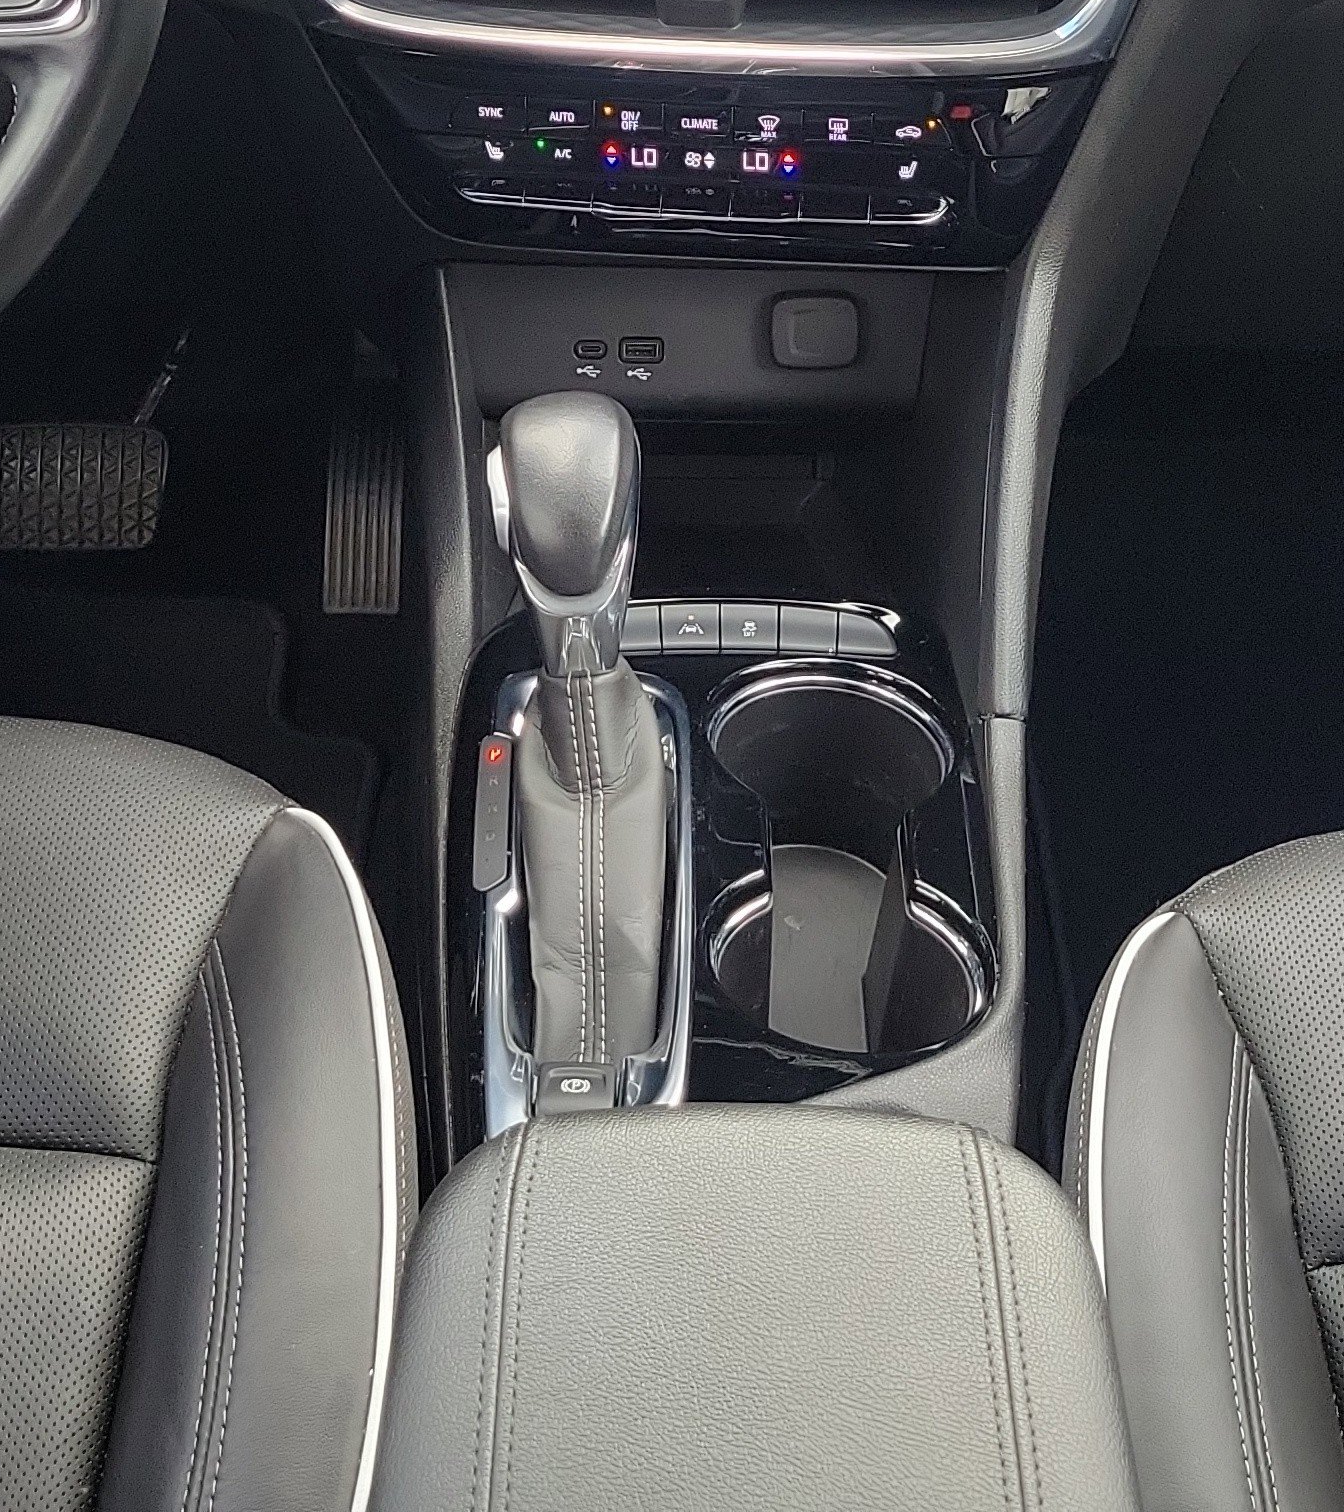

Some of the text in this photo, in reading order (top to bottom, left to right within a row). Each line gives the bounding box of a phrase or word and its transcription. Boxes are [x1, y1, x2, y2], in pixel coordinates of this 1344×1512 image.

[478, 107, 504, 118] SYNC
[549, 111, 575, 123] AUTO
[621, 111, 641, 122] ON/
[621, 121, 639, 131] OFF
[681, 118, 719, 130] CLIMATE
[554, 148, 572, 159] A/C
